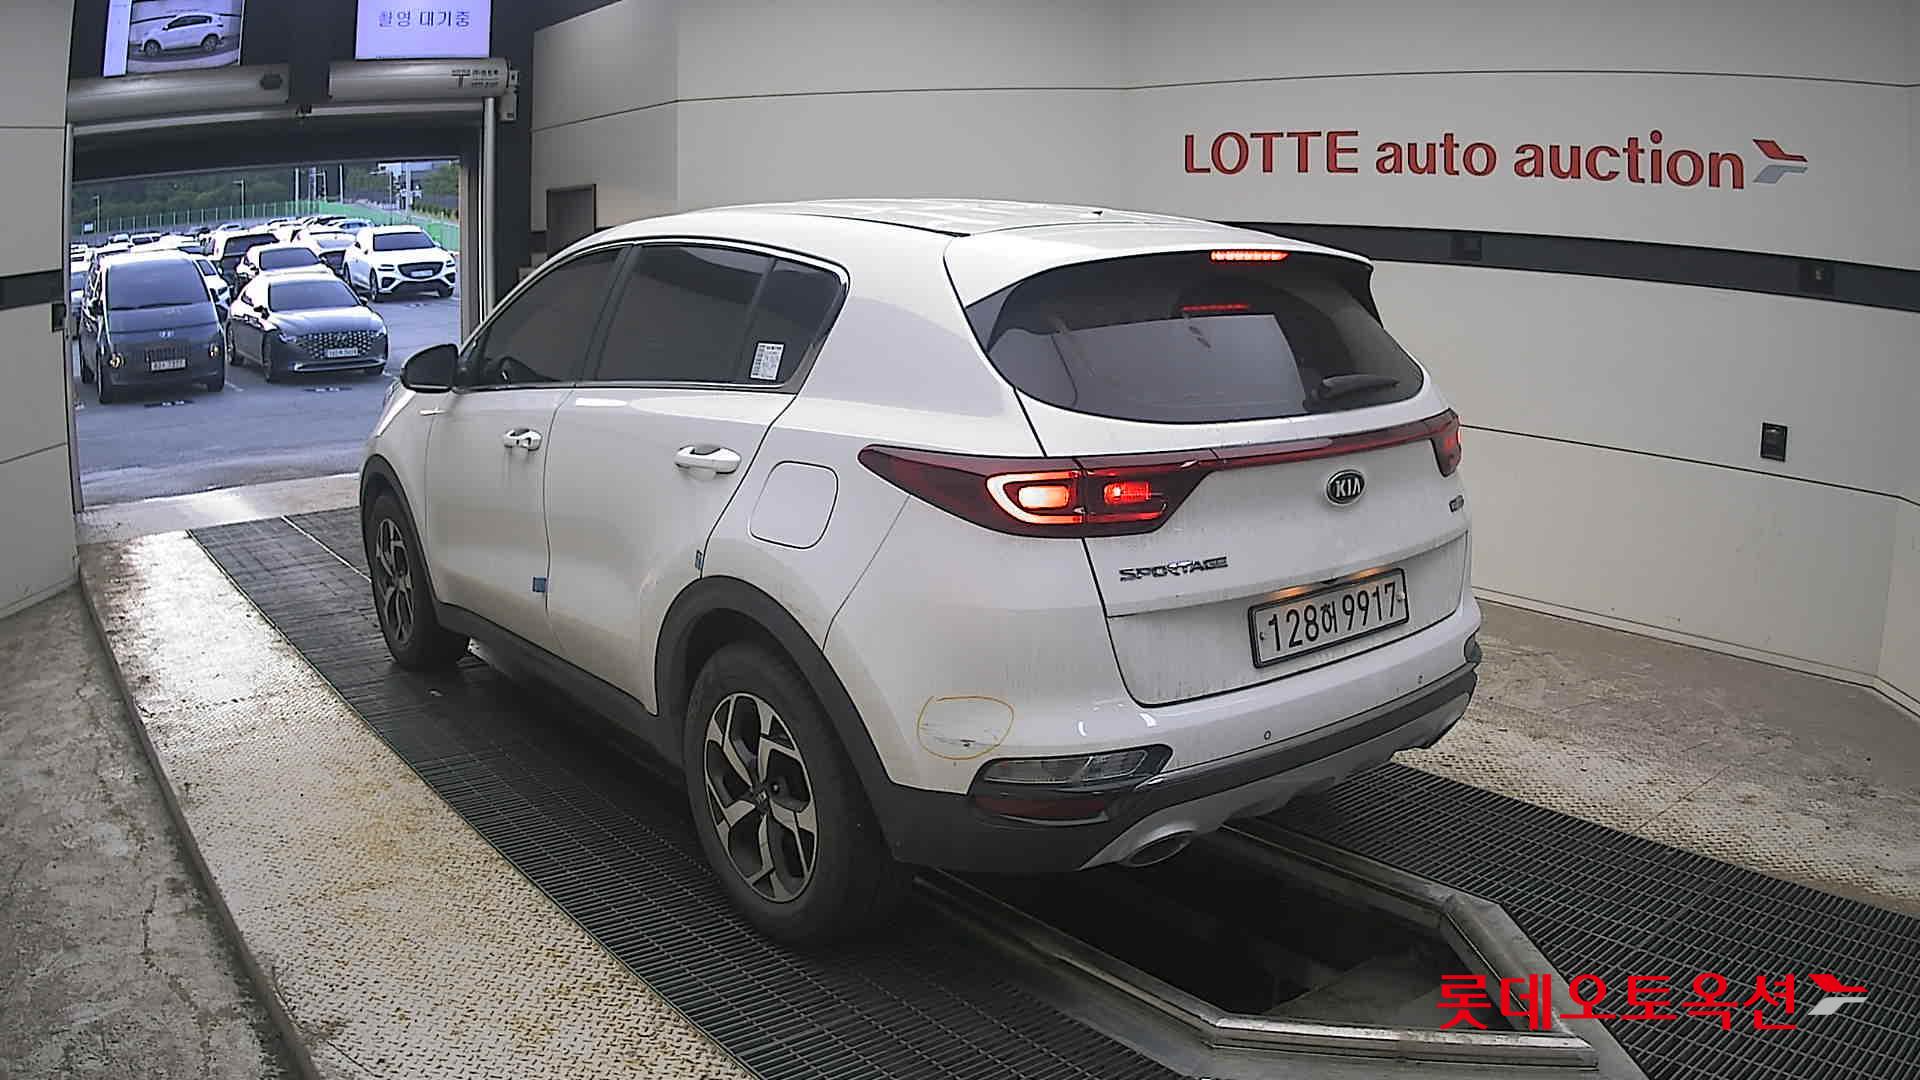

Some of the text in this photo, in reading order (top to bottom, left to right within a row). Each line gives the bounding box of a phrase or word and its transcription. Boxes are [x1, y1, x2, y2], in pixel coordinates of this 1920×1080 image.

[420, 10, 470, 28] 대기중
[1185, 129, 1746, 189] LOTTE auto auction
[1335, 477, 1361, 498] KIA
[1119, 556, 1228, 582] SPORTAGE
